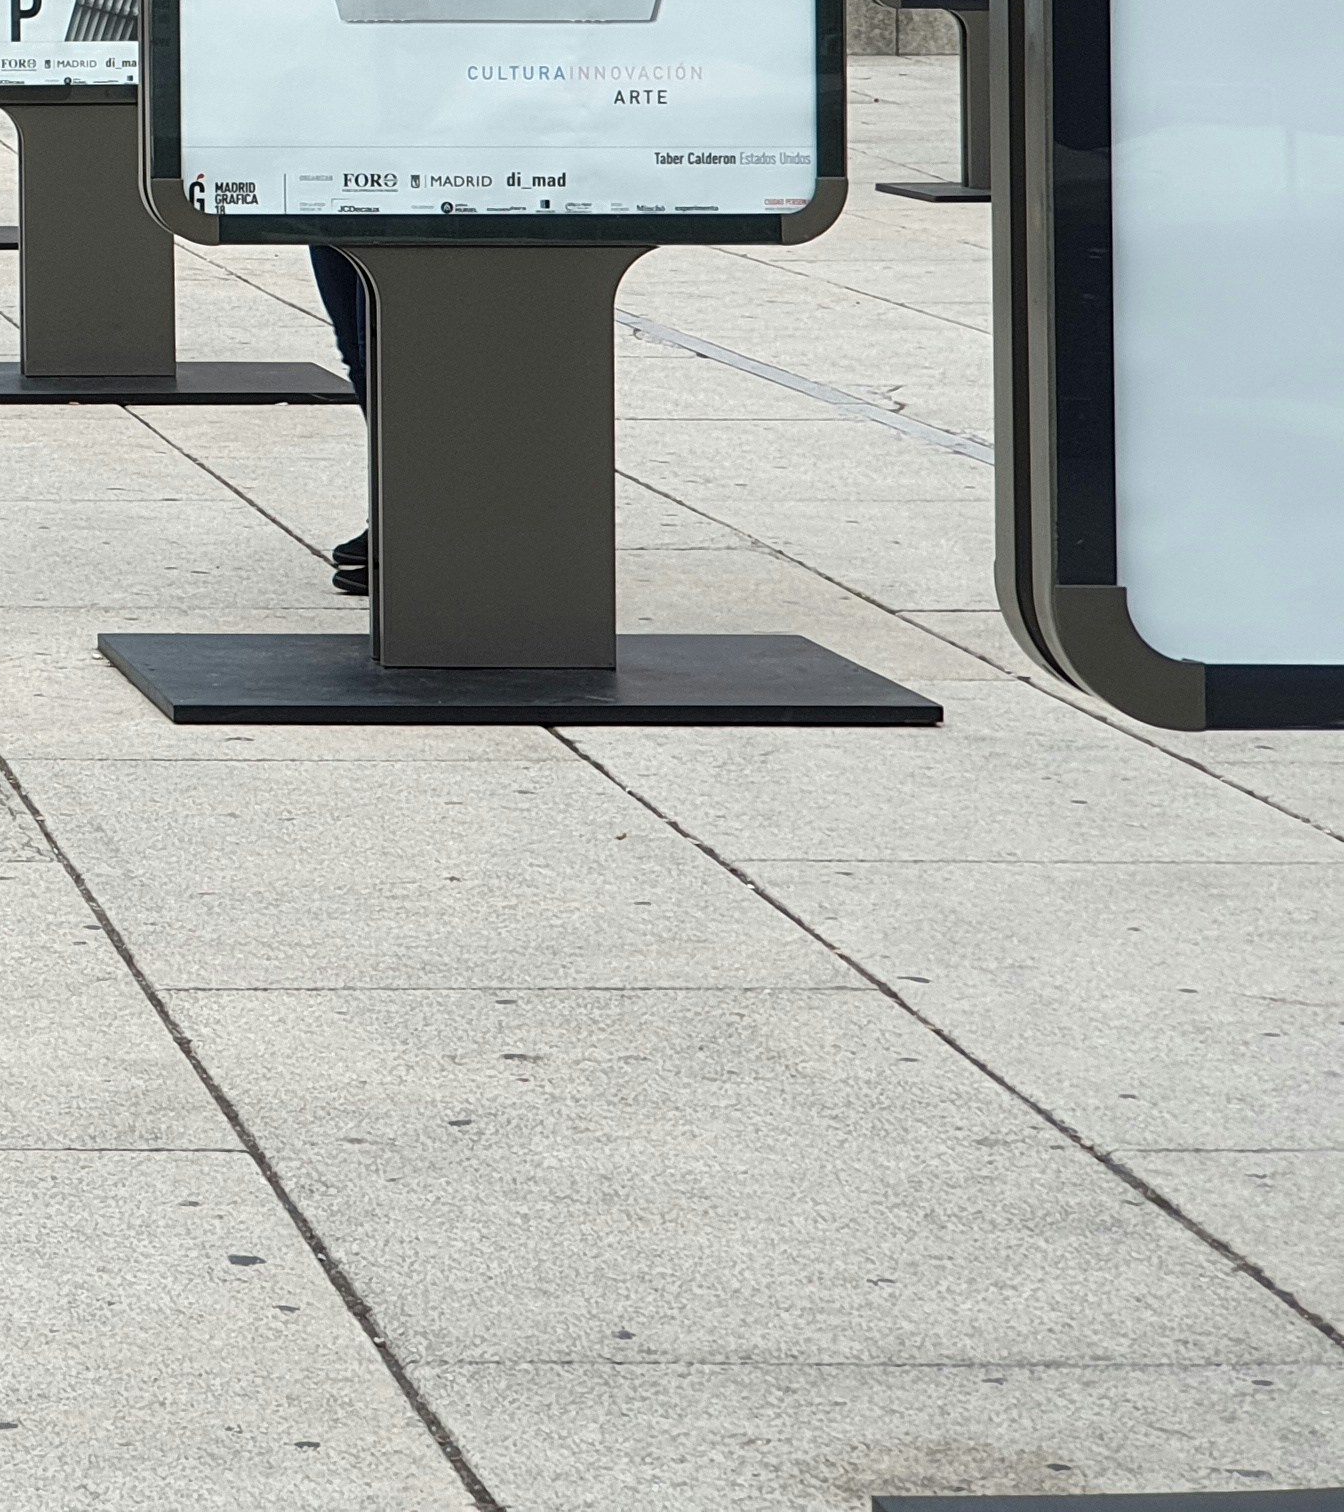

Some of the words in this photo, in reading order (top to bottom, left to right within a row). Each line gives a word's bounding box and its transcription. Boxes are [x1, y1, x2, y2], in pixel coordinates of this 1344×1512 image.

[57, 59, 98, 68] MADRID
[613, 89, 668, 105] ARTE
[654, 152, 684, 165] Taber
[687, 152, 737, 165] Calderon
[739, 151, 776, 165] Estados
[779, 151, 812, 165] Unidos
[215, 182, 256, 193] MADRID
[430, 175, 493, 188] MADRID
[506, 172, 567, 190] di_mad
